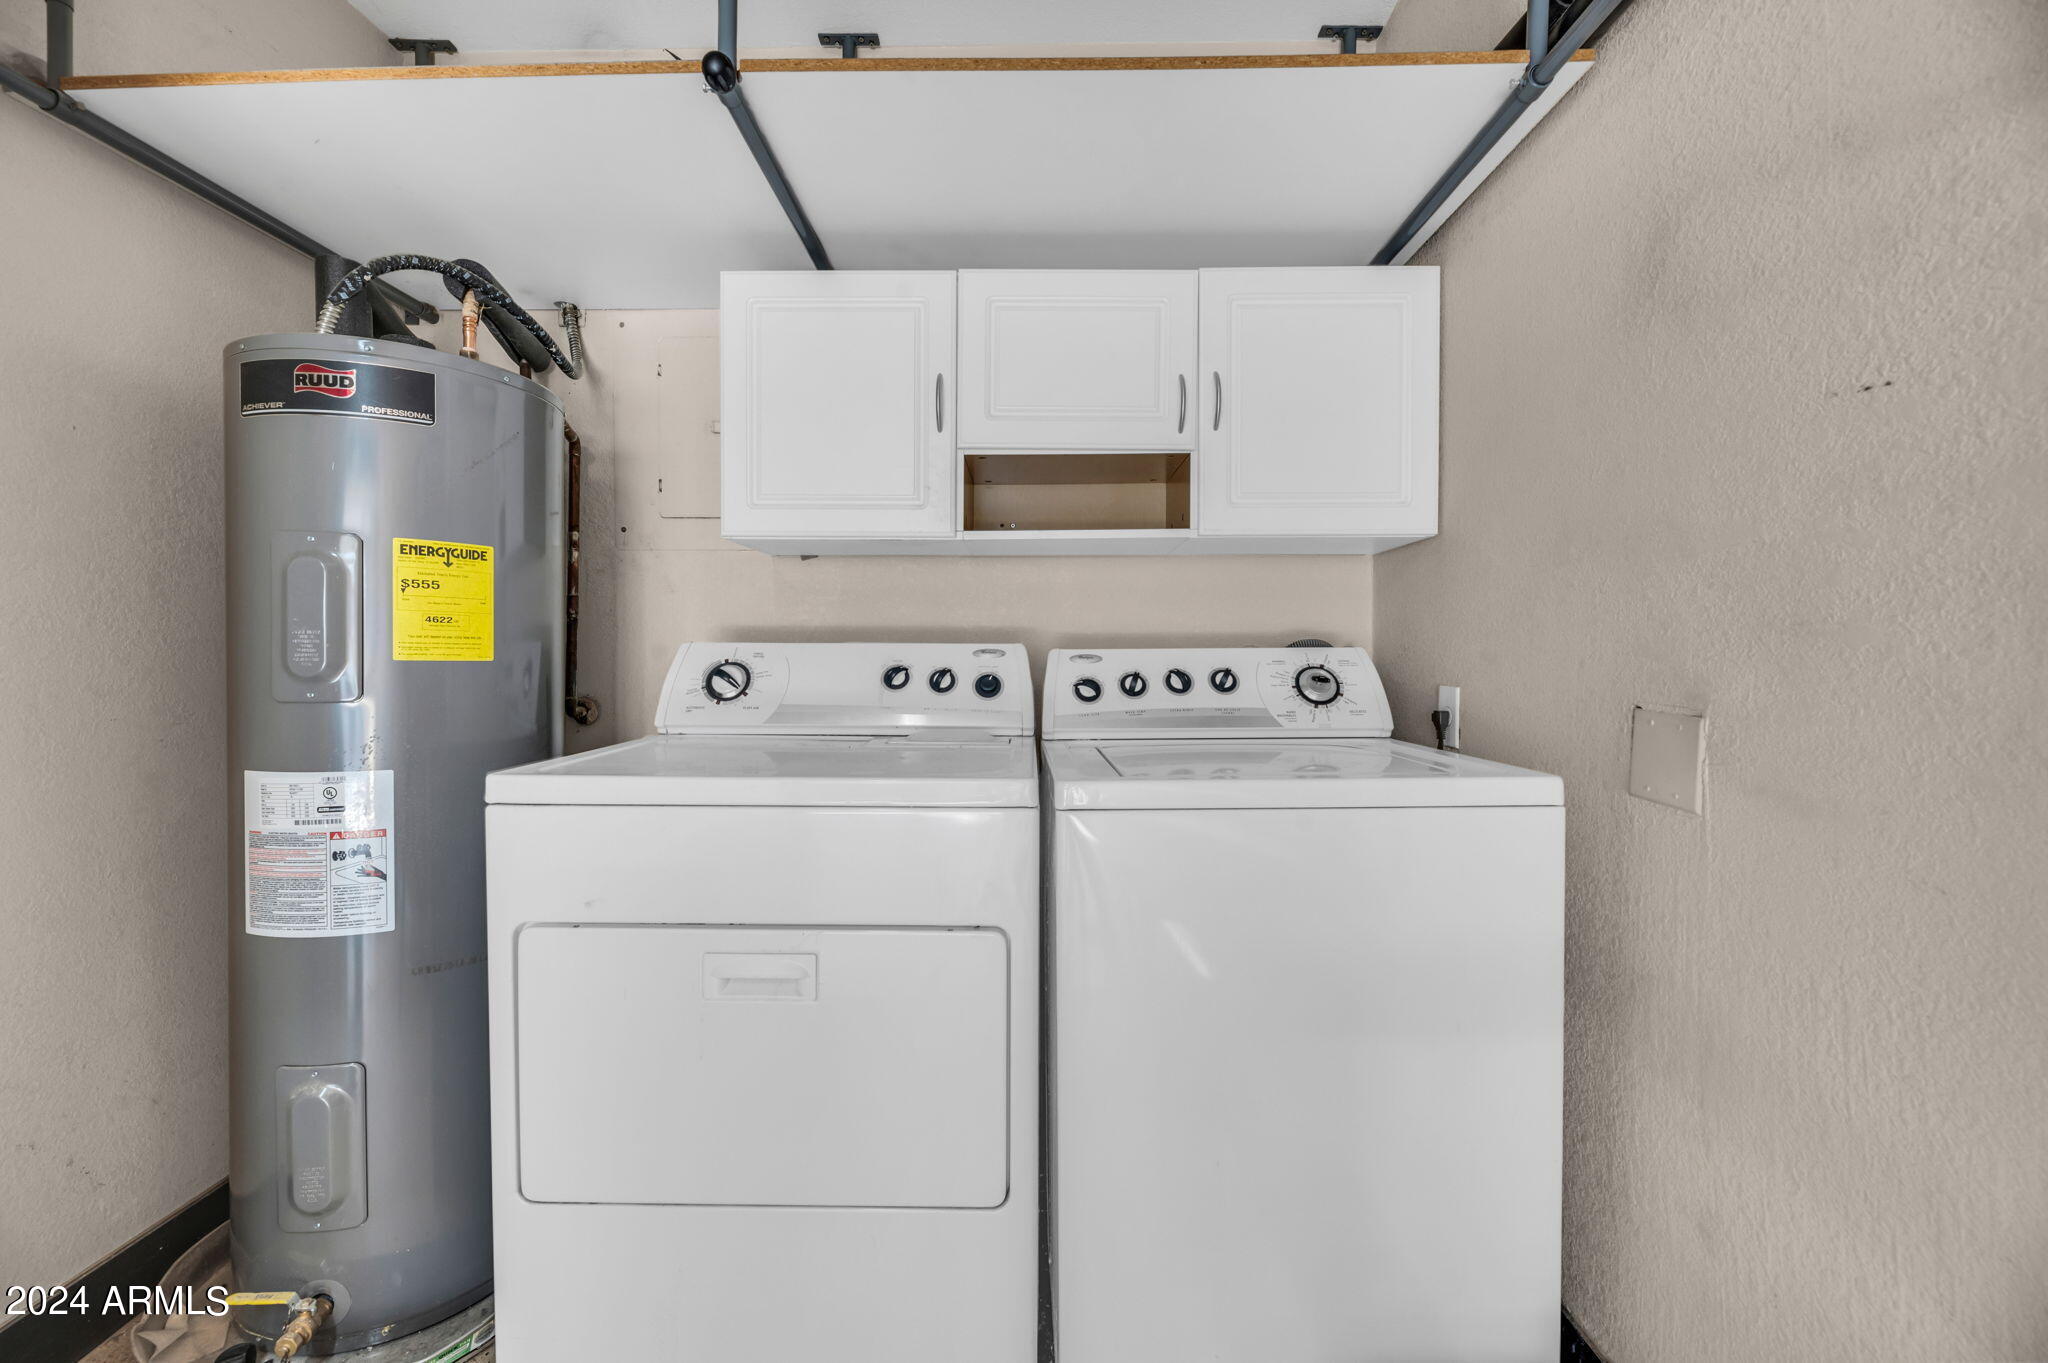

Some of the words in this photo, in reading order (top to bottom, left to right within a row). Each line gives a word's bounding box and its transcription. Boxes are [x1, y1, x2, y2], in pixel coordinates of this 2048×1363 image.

[294, 373, 355, 388] RUUD
[242, 402, 283, 411] ACHIEVER
[361, 405, 432, 421] PROFESSIONAL
[399, 544, 488, 562] ENERGYGUIDE
[400, 578, 440, 590] $555
[425, 615, 453, 624] 4622
